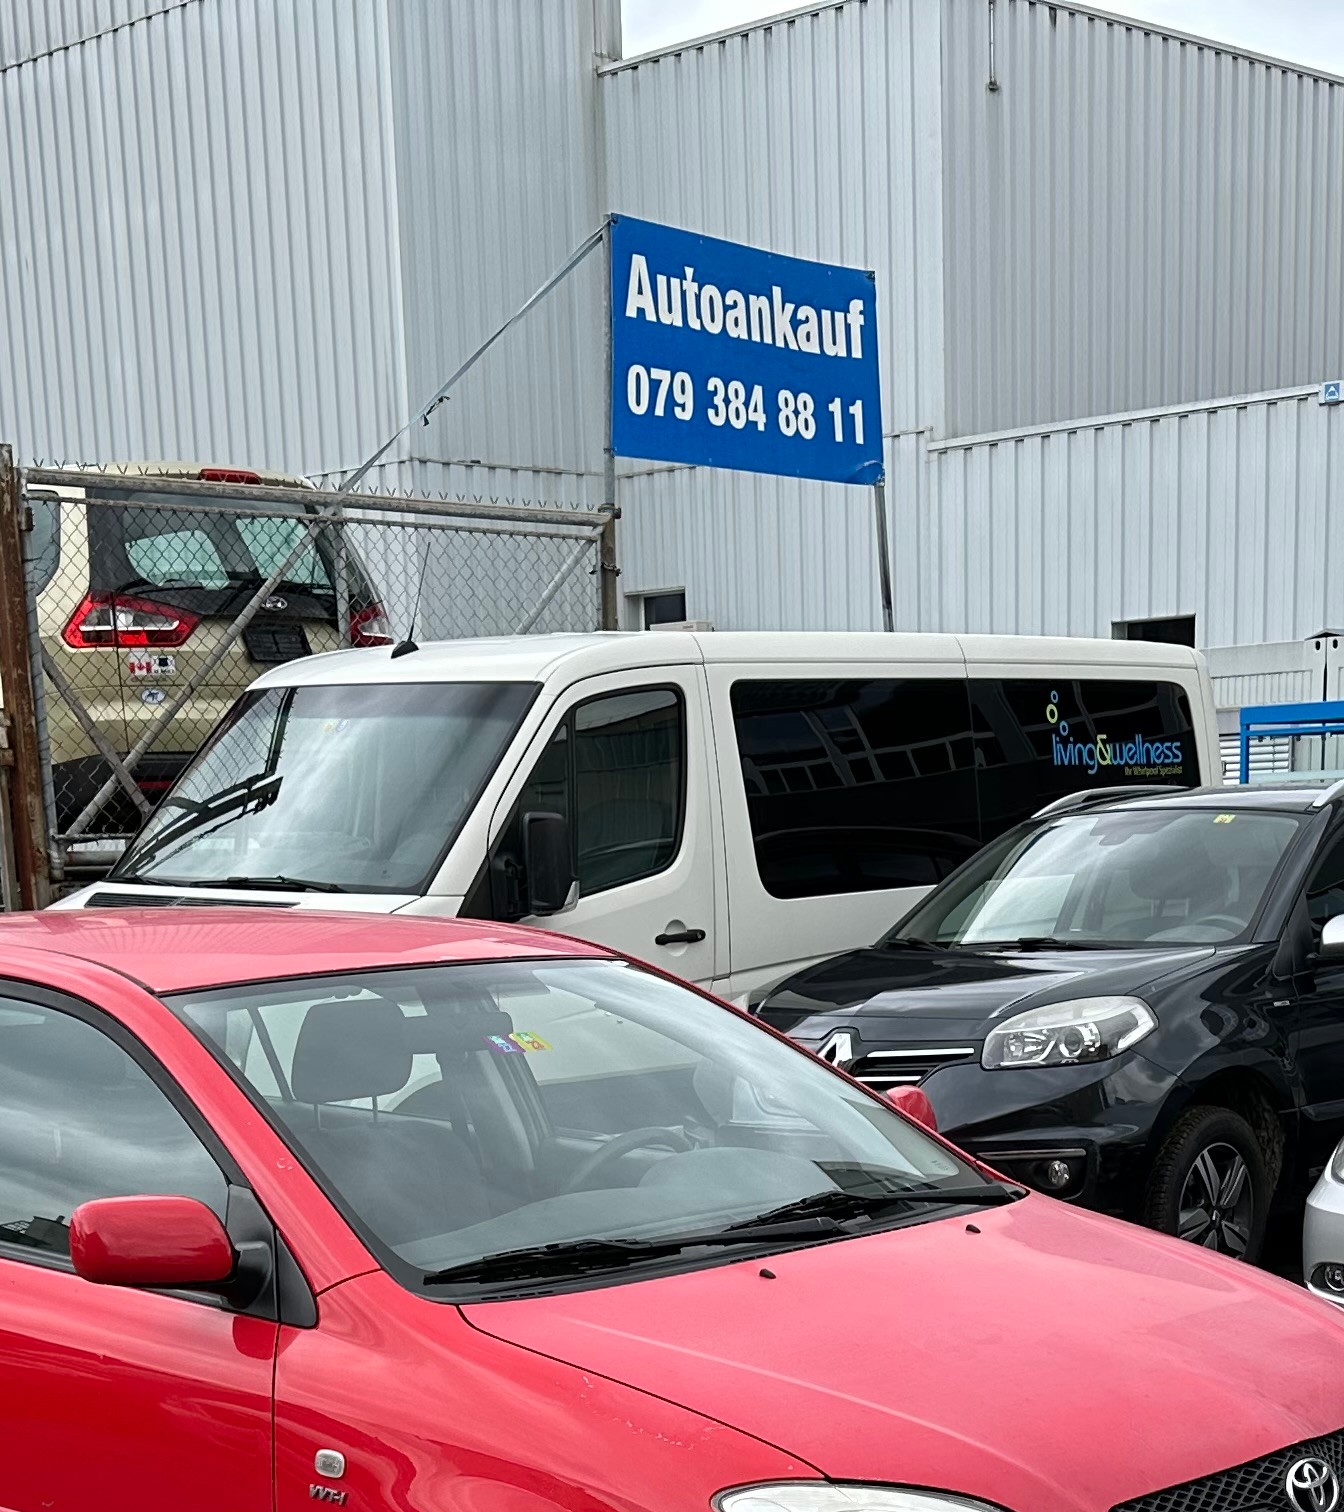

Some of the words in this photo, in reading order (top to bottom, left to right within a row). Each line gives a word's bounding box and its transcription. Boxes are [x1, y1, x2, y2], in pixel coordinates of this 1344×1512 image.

[625, 253, 865, 359] Autoankauf
[627, 364, 694, 421] 079
[707, 376, 766, 432] 384
[778, 389, 816, 440] 88
[828, 397, 864, 445] 11
[1052, 733, 1183, 775] living&wellness
